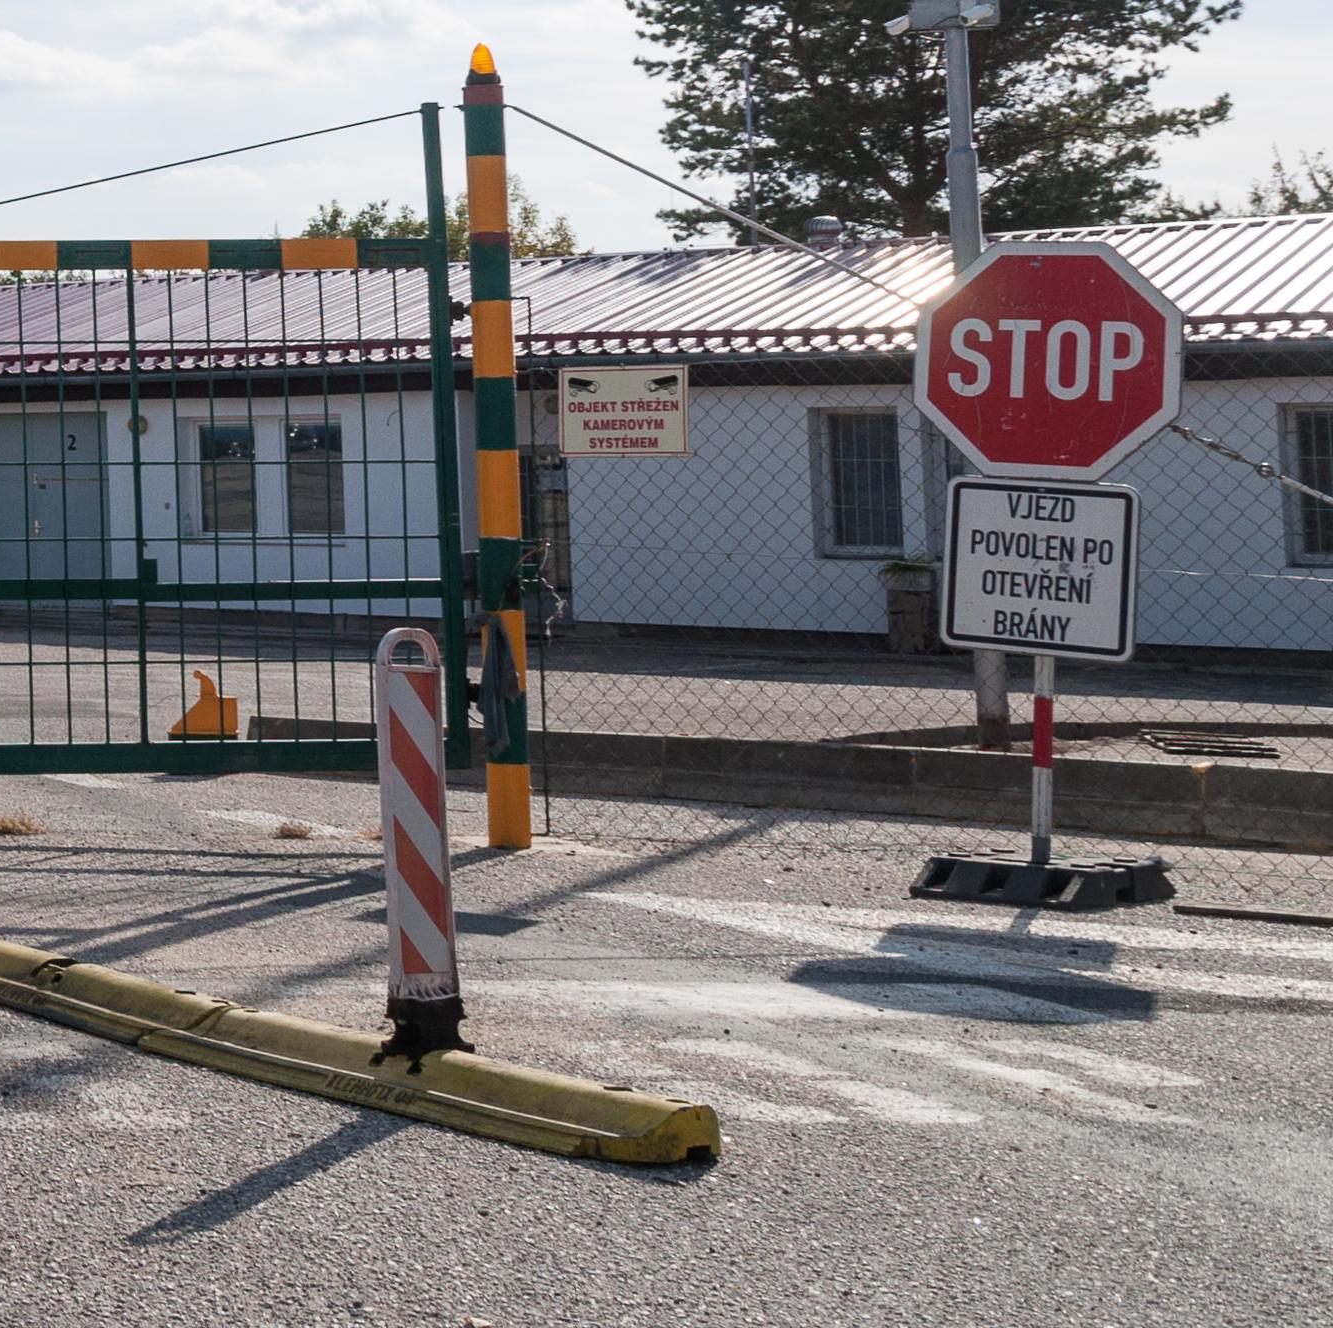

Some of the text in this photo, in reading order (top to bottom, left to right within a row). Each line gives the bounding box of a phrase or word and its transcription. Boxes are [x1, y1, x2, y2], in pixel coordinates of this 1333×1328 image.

[947, 317, 1145, 402] STOP
[568, 398, 679, 413] OBJEKT STŘEŽEN
[583, 416, 665, 431] KAMEROVÝM
[67, 434, 77, 451] 2
[589, 434, 659, 449] SYSTÉMEM
[1007, 492, 1076, 523] VJEZD
[970, 528, 1114, 566] POVOLEN PO
[981, 567, 1094, 605] OTEVŘENÍ
[993, 607, 1071, 642] BRÁNY
